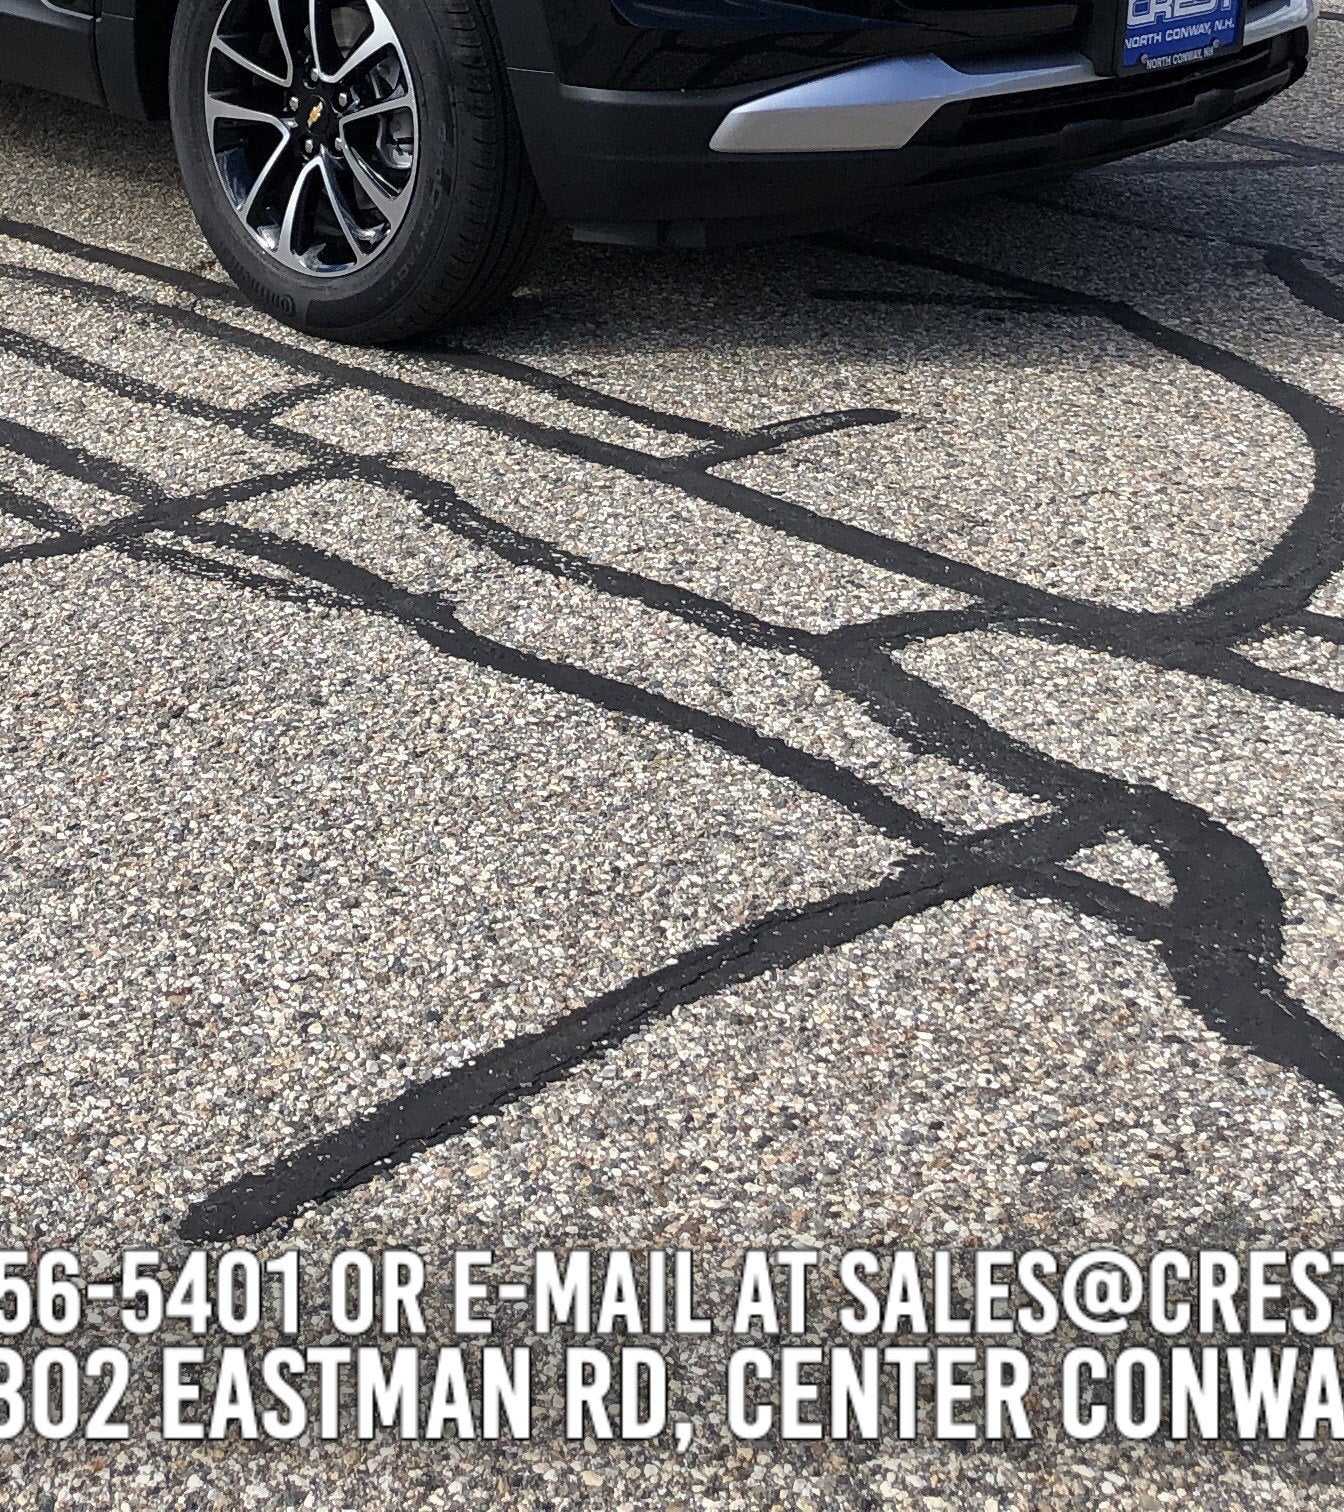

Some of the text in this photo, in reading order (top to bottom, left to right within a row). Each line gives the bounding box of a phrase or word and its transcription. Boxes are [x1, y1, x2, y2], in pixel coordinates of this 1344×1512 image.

[1124, 17, 1235, 49] NORTH CONWAY, N.H.
[1146, 56, 1172, 70] NORTH
